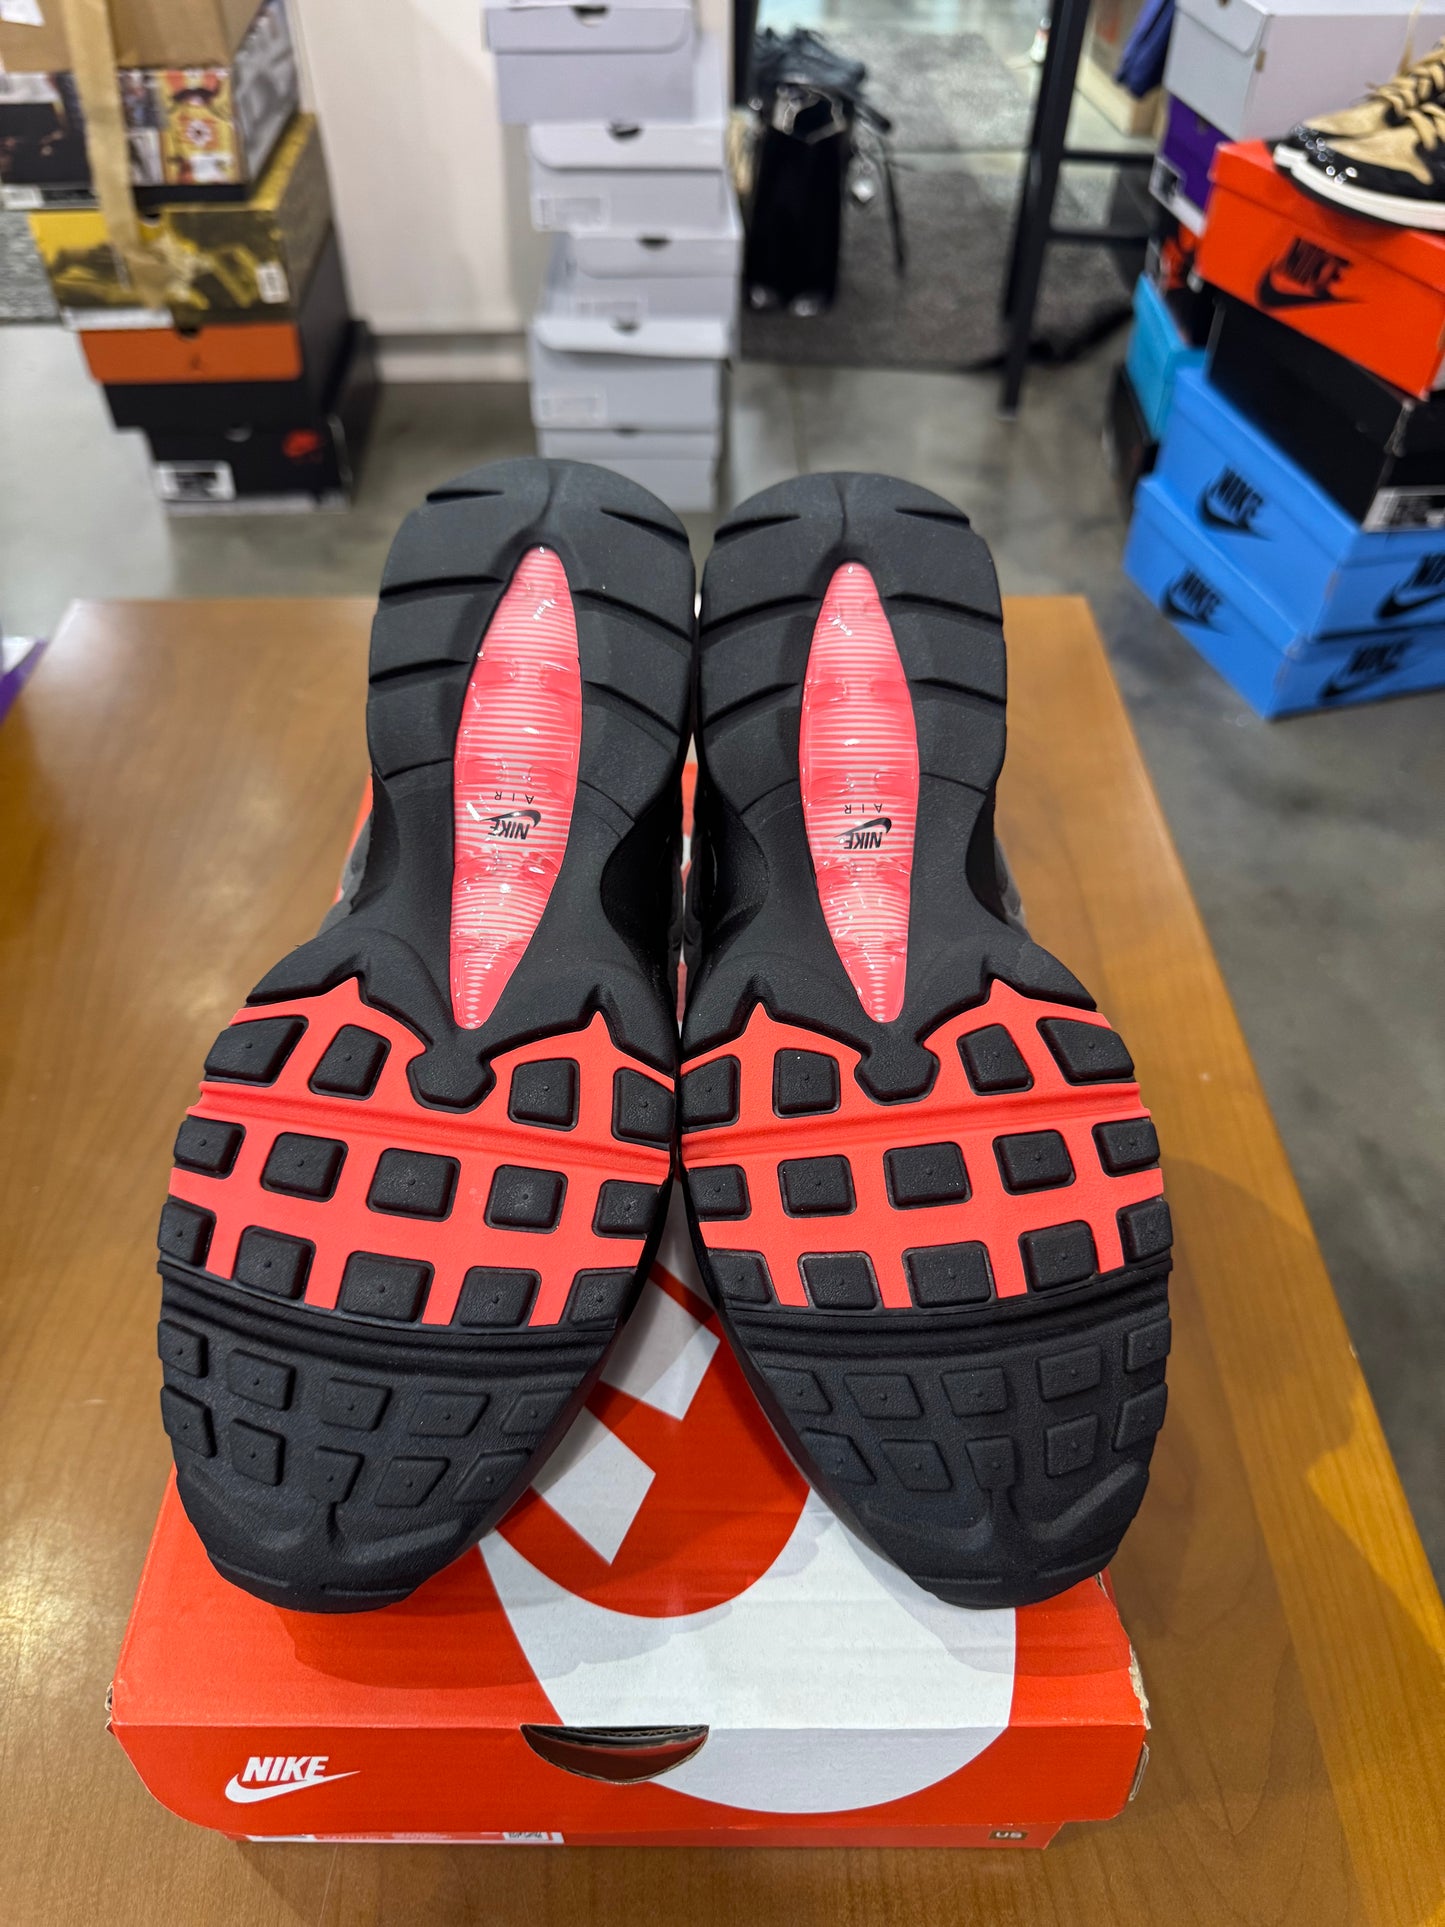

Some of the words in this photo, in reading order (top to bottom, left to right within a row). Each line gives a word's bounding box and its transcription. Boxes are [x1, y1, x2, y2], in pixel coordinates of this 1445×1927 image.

[1278, 236, 1351, 296] NIKE
[1210, 468, 1263, 525] NIKE
[1171, 568, 1221, 622] NIKE
[494, 791, 534, 804] AIR
[844, 803, 882, 814] AIR
[488, 819, 529, 839] NIKE
[844, 832, 882, 849] NIKE
[242, 1757, 328, 1781] NIKE
